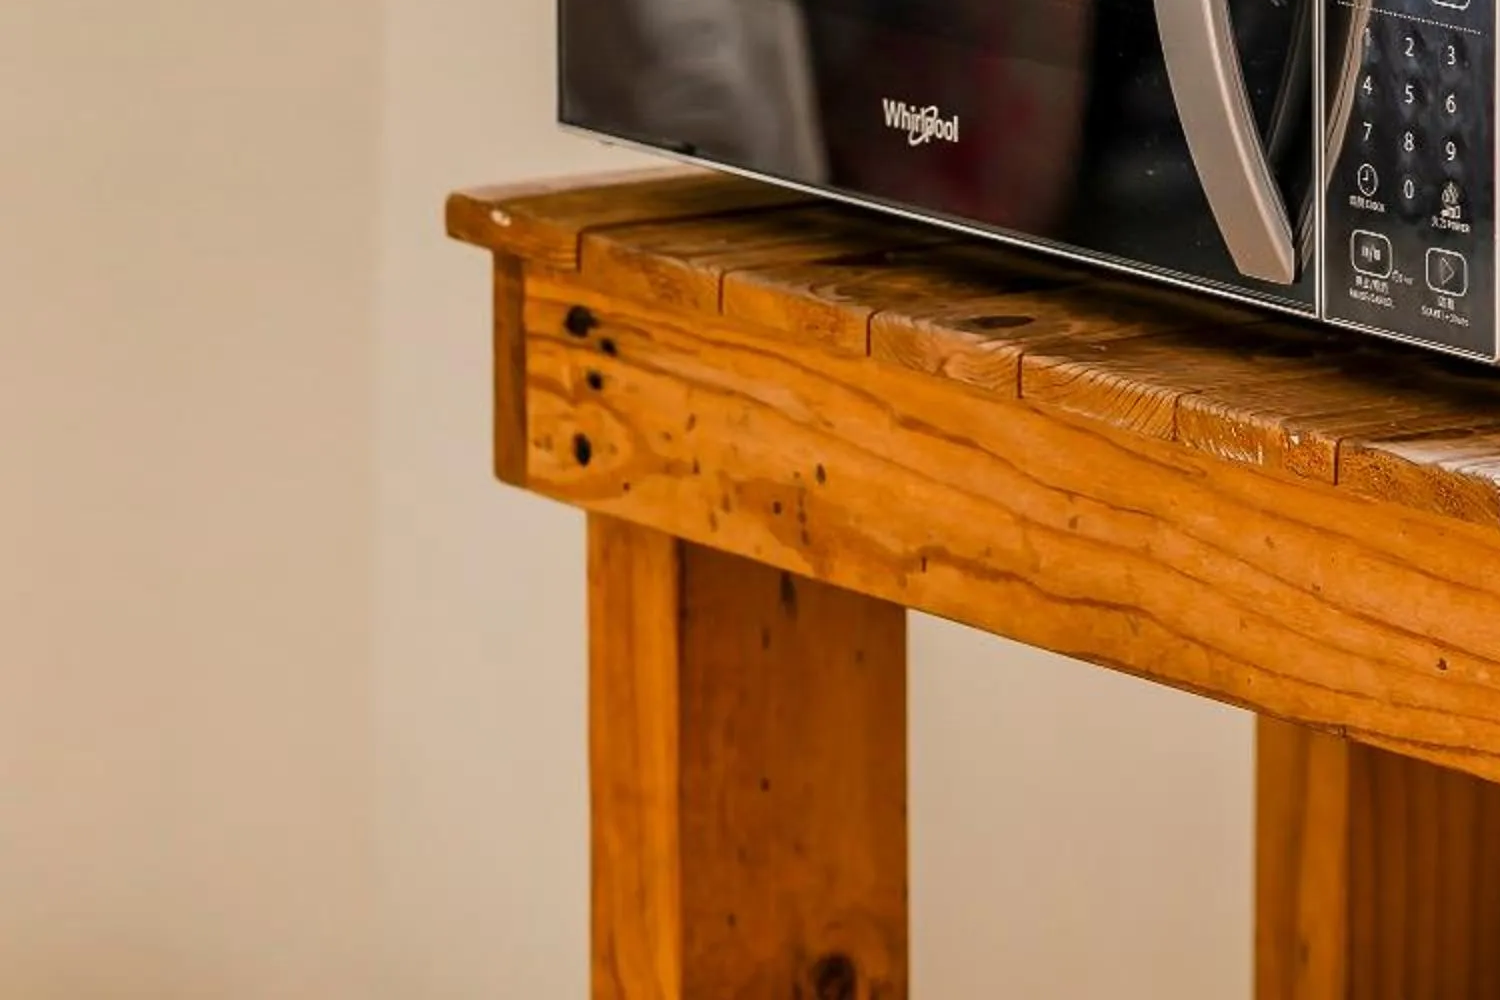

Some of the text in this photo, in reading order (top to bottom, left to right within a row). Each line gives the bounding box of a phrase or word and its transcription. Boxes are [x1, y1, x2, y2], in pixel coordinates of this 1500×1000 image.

[1404, 37, 1415, 57] 2
[1446, 45, 1457, 65] 3
[1362, 75, 1373, 95] 4
[1404, 83, 1415, 104] 5
[1445, 94, 1457, 114] 6
[882, 98, 959, 146] Whirlpool
[1362, 121, 1373, 141] 7
[1403, 131, 1415, 152] 8
[1445, 141, 1457, 161] 9
[1403, 179, 1415, 199] 0
